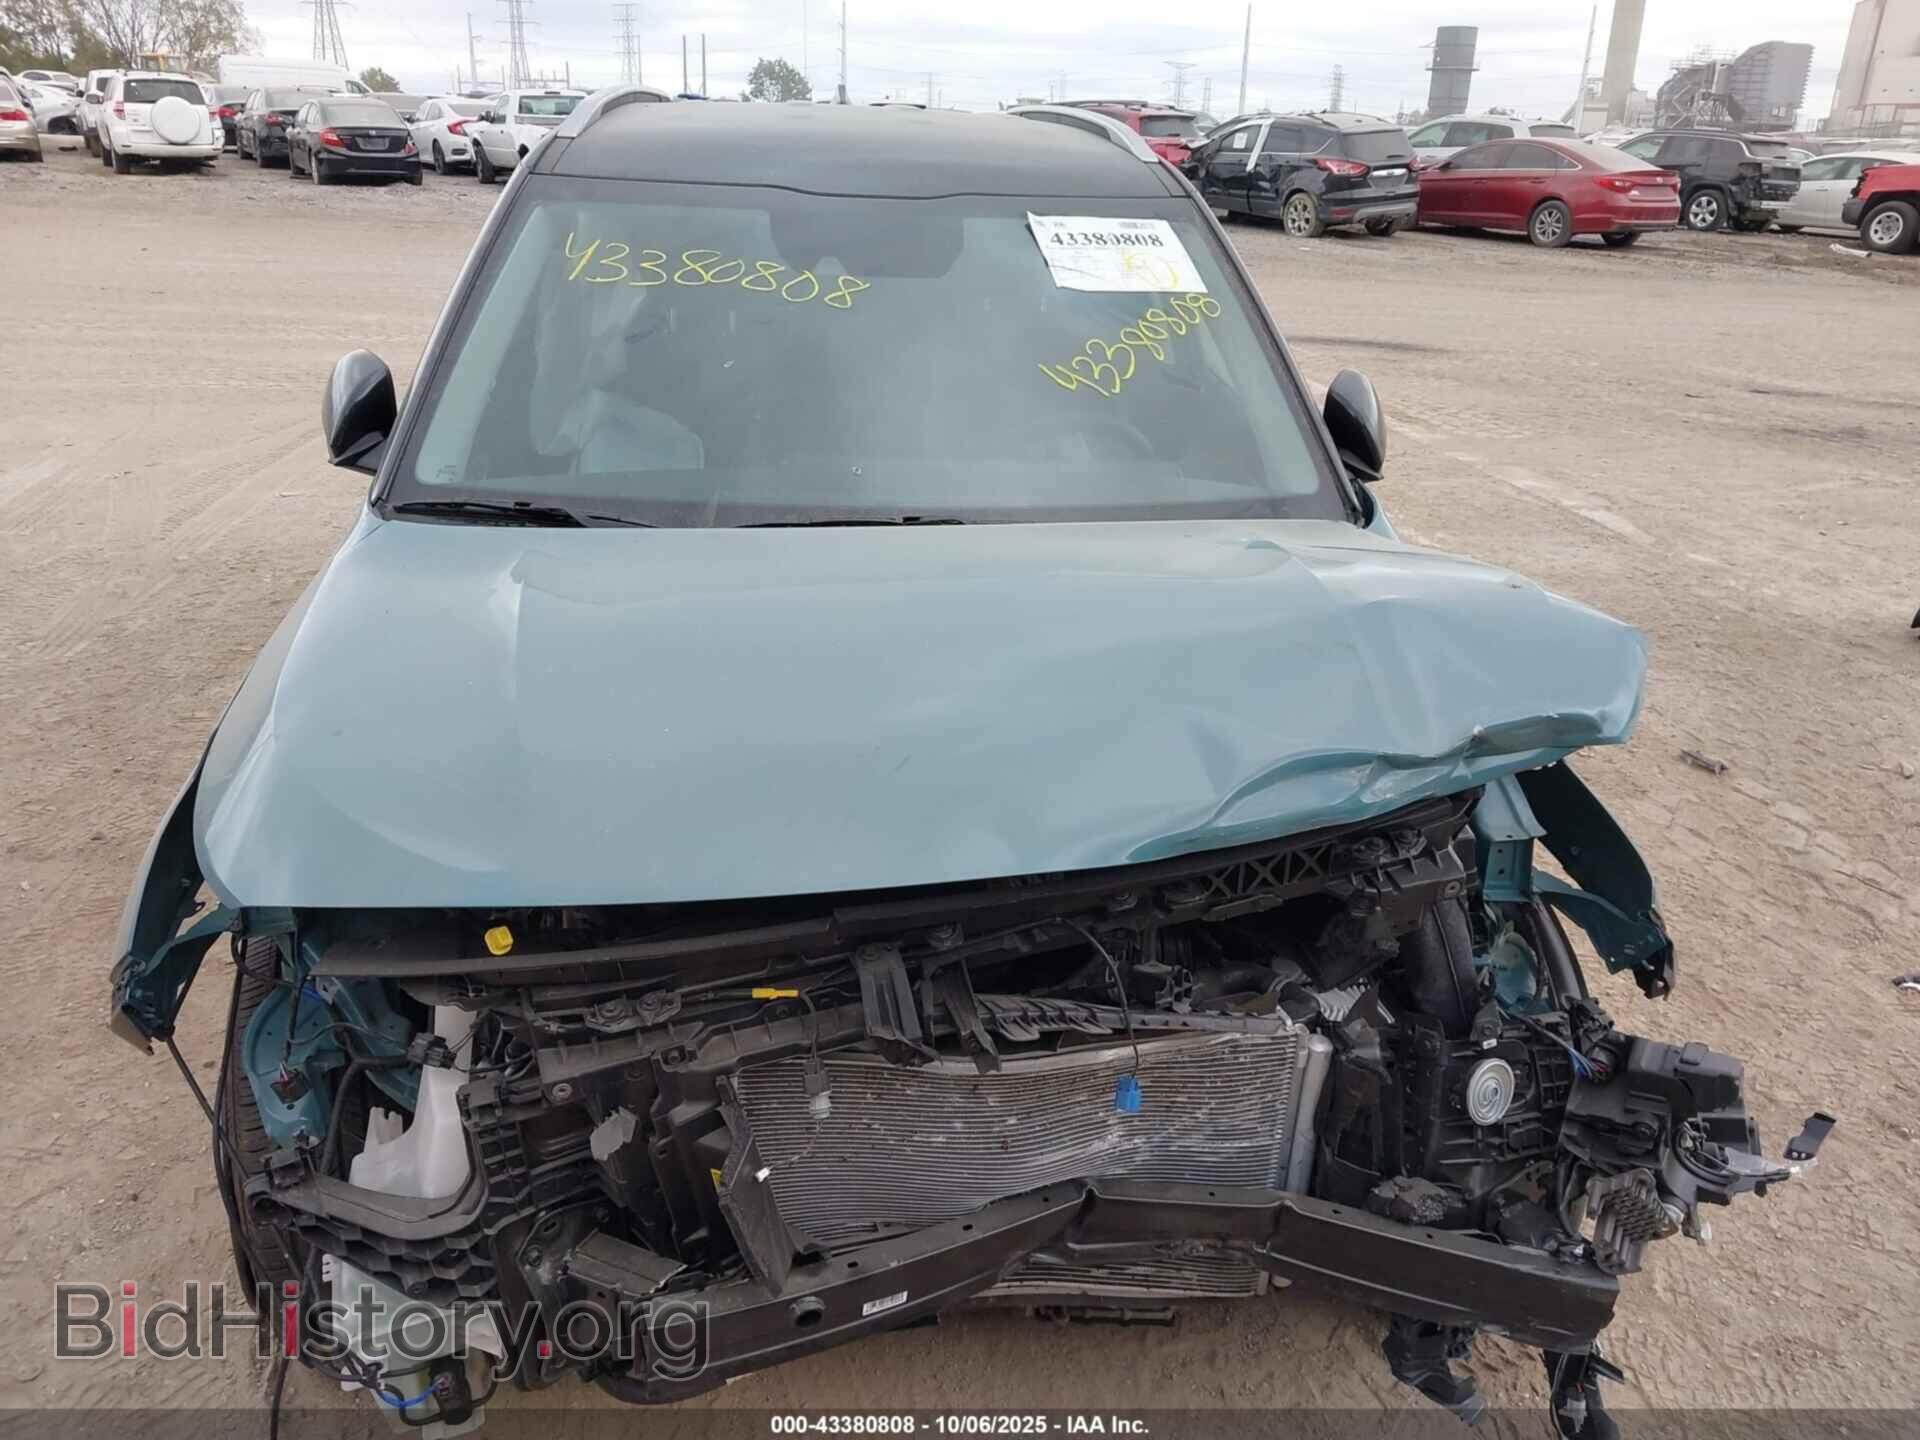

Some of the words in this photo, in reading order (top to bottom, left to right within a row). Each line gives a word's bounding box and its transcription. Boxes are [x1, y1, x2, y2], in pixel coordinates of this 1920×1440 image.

[565, 232, 871, 309] 43380808
[1049, 232, 1164, 247] 43380808
[1037, 293, 1221, 396] 43380808
